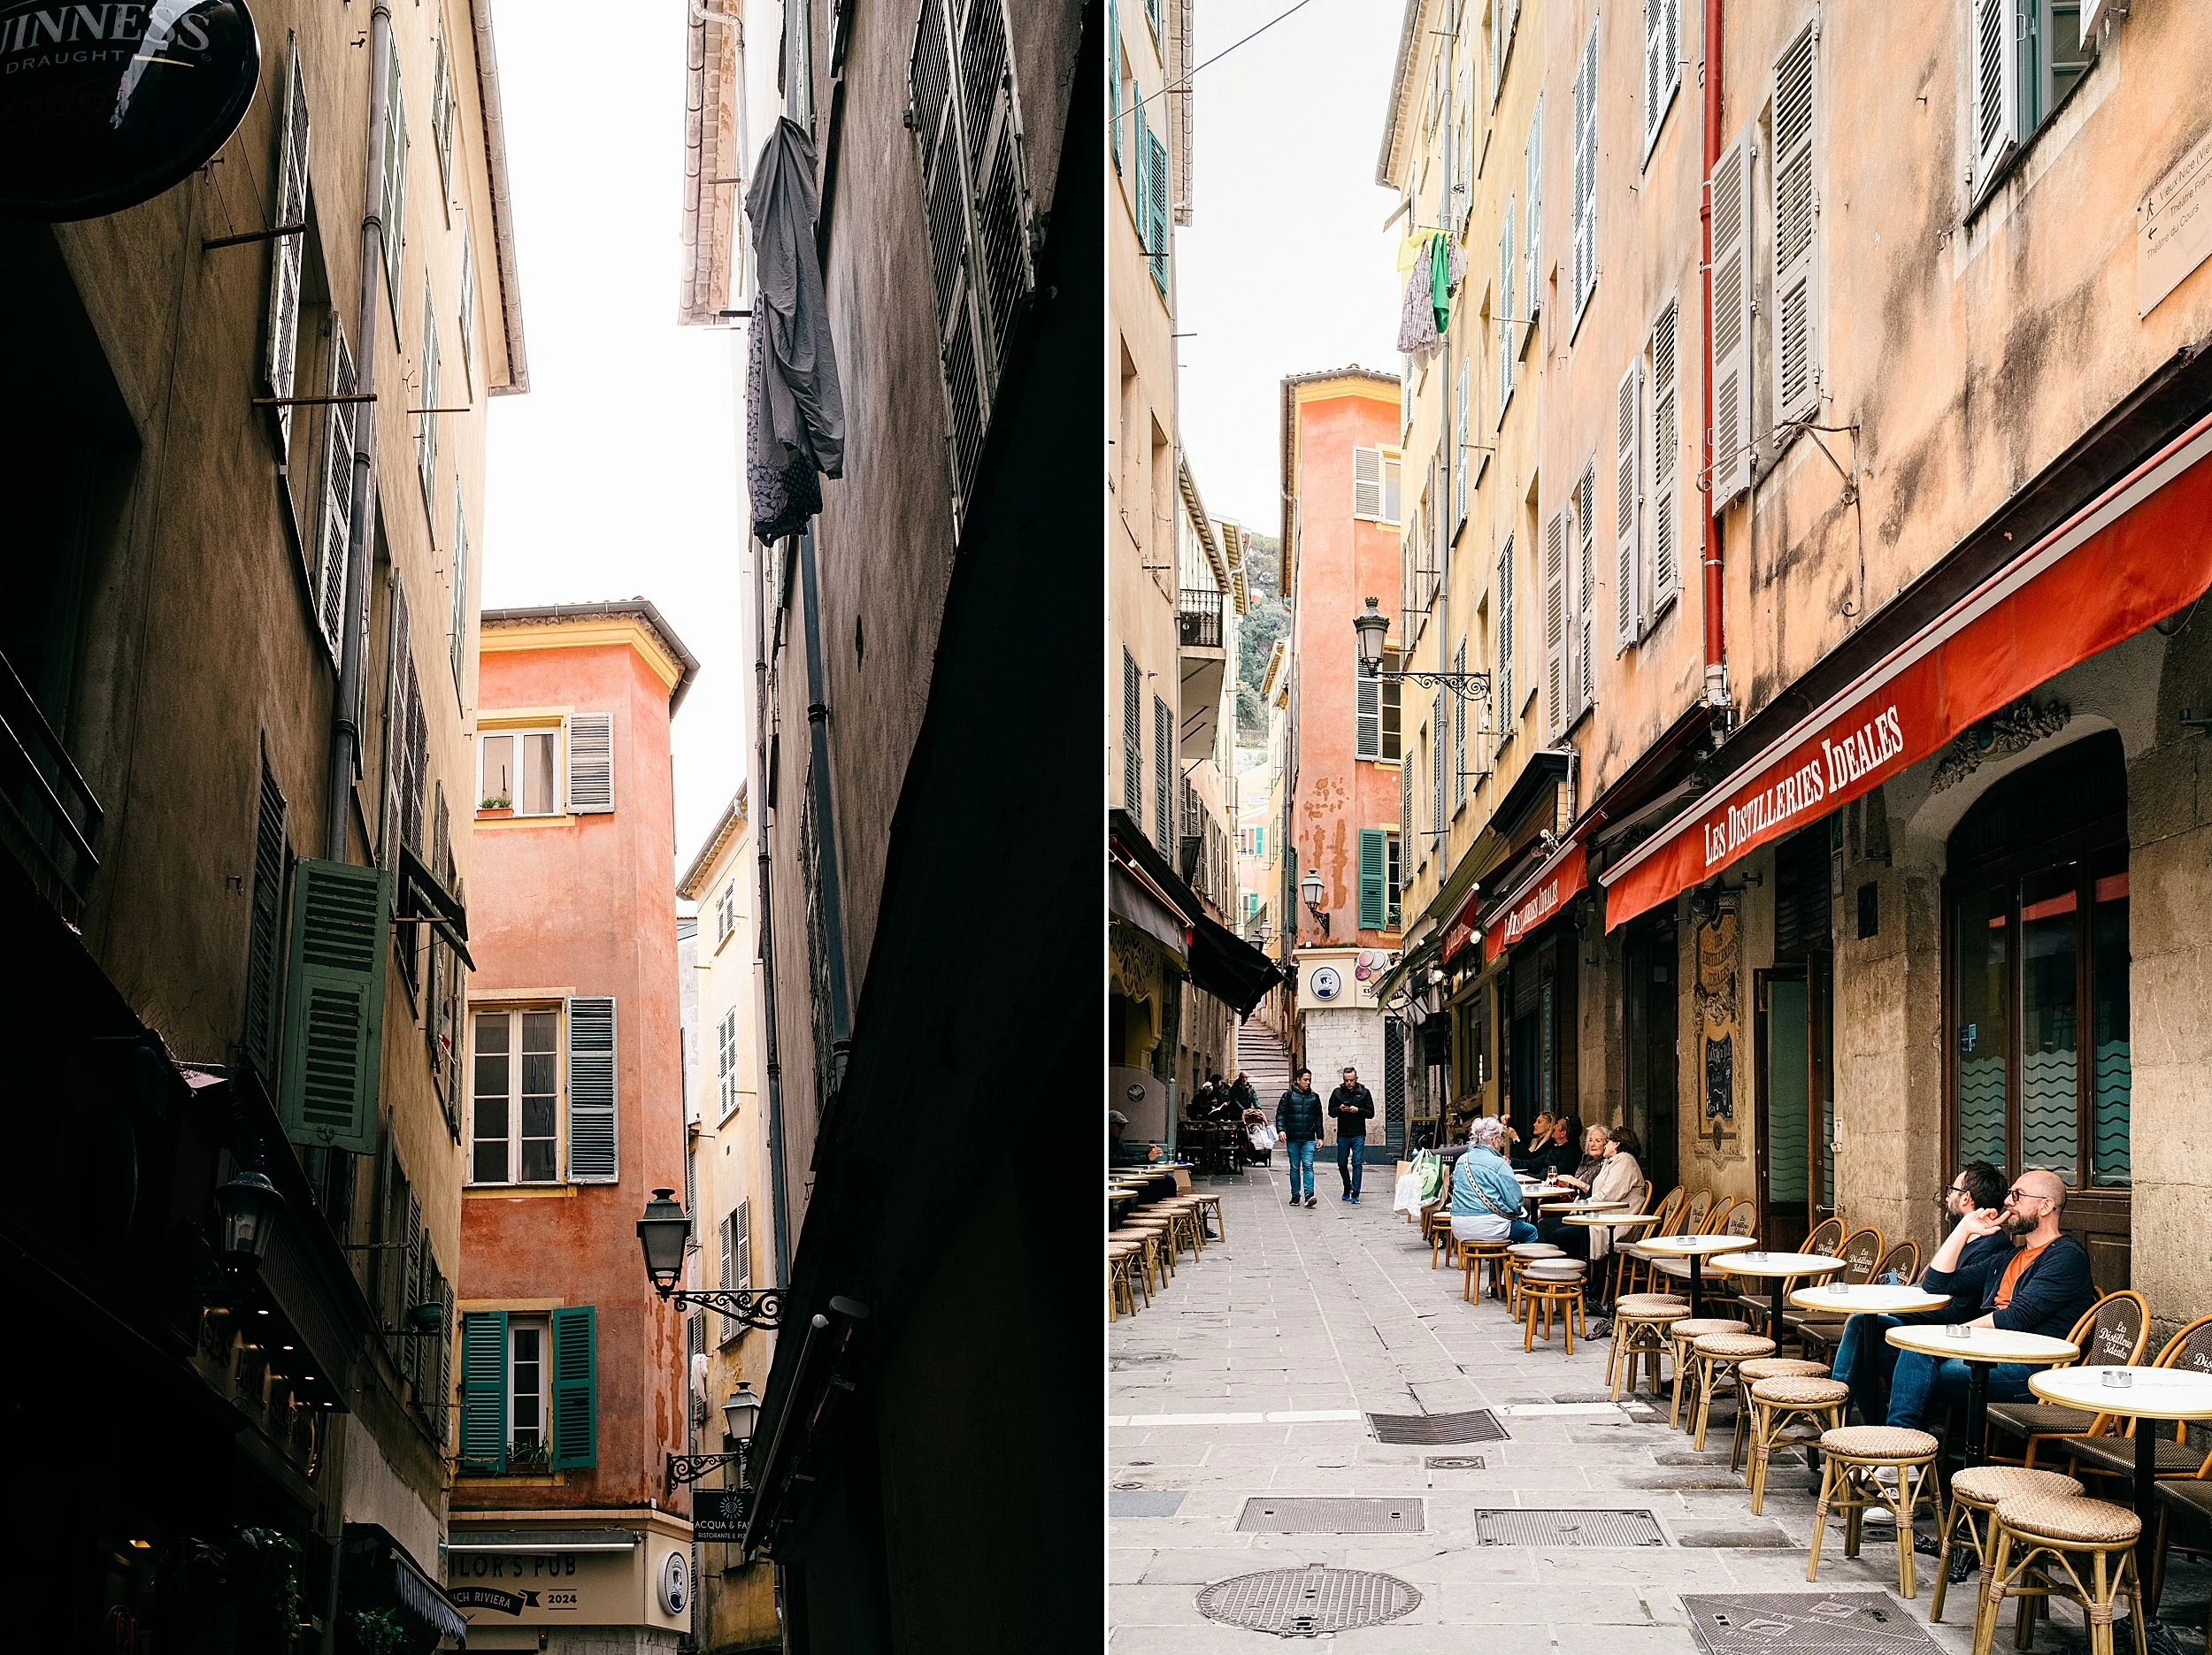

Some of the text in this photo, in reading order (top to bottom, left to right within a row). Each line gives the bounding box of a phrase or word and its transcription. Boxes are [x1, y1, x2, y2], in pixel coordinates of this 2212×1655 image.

[6, 50, 126, 75] DRAUGHT
[2159, 177, 2177, 201] Vieux
[2178, 158, 2196, 182] Nice
[2170, 189, 2193, 218] Théâtre
[2170, 222, 2179, 238] du
[2179, 203, 2200, 227] Cours
[1704, 704, 1904, 867] LES DISTILLERIES IDEALES
[2116, 1321, 2127, 1334] Les
[695, 1520, 726, 1530] ACQUA
[534, 1556, 576, 1577] PUB
[474, 1591, 511, 1609] RIVIERA
[548, 1594, 577, 1605] 2024
